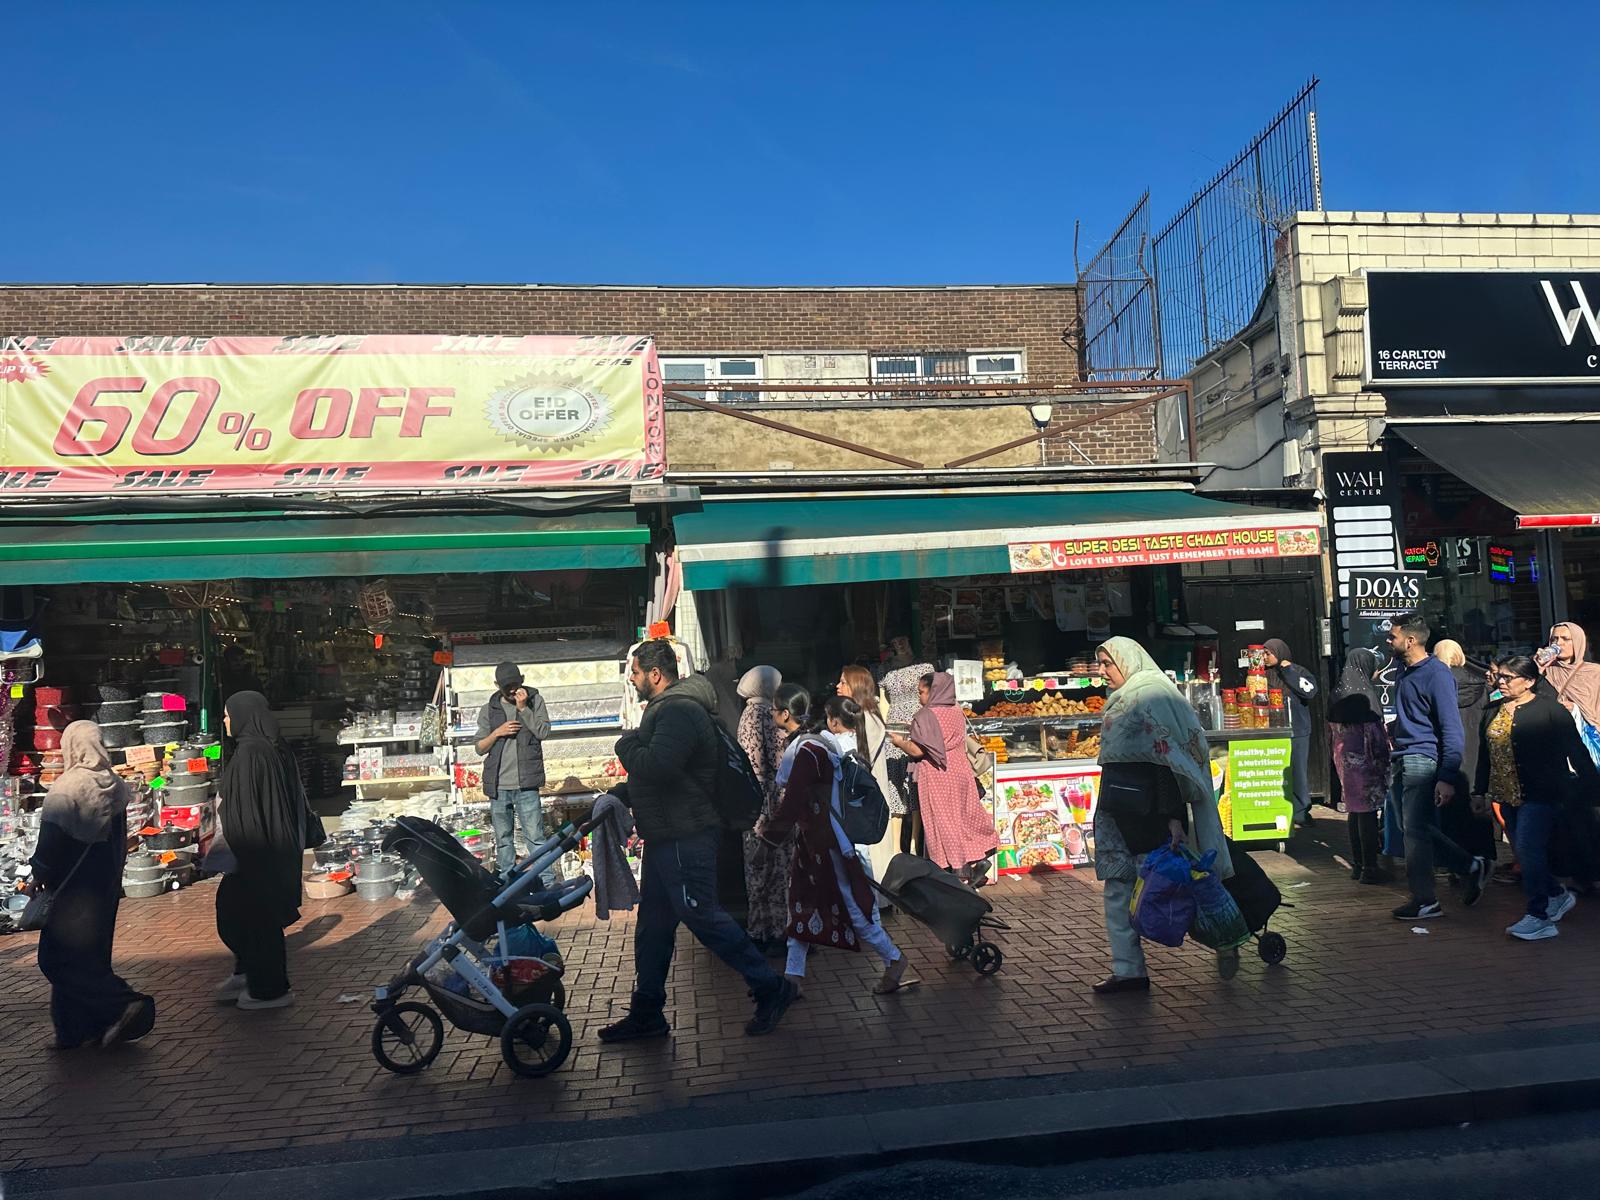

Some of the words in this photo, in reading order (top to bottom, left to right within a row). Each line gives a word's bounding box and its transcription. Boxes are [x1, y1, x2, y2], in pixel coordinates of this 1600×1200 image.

[1378, 350, 1390, 360] 16
[1392, 350, 1447, 360] CARLTON
[1379, 360, 1439, 371] TERRACET
[534, 396, 568, 409] EID
[647, 361, 662, 455] LONDON
[289, 387, 456, 440] OFF
[519, 409, 580, 421] OFFER
[112, 469, 215, 488] SALE
[273, 466, 374, 486] SALE
[441, 465, 530, 483] SALE
[572, 463, 664, 481] SALE
[1336, 470, 1384, 487] WAH
[1340, 488, 1382, 497] CENTER
[1065, 539, 1109, 556] SUPER
[1112, 537, 1141, 553] DESI
[1143, 535, 1184, 551] TASTE
[1186, 532, 1231, 548] CHAAT
[1232, 529, 1275, 545] HOUSE
[1070, 556, 1094, 566] LOVE
[1096, 555, 1114, 564] THE
[1115, 553, 1148, 564] TASTE,
[1149, 552, 1172, 563] JUST
[1173, 548, 1225, 561] REMEMBER
[1227, 548, 1245, 557] THE
[1247, 546, 1275, 556] NAME
[1355, 576, 1420, 598] DOA'S
[1355, 598, 1420, 609] JEWELLERY
[1233, 749, 1265, 758] Healthy,
[1266, 747, 1287, 756] Juicy
[1243, 759, 1283, 767] Nutritious
[1238, 770, 1255, 778] High
[1265, 768, 1284, 776] Fibre
[1234, 781, 1252, 789] High
